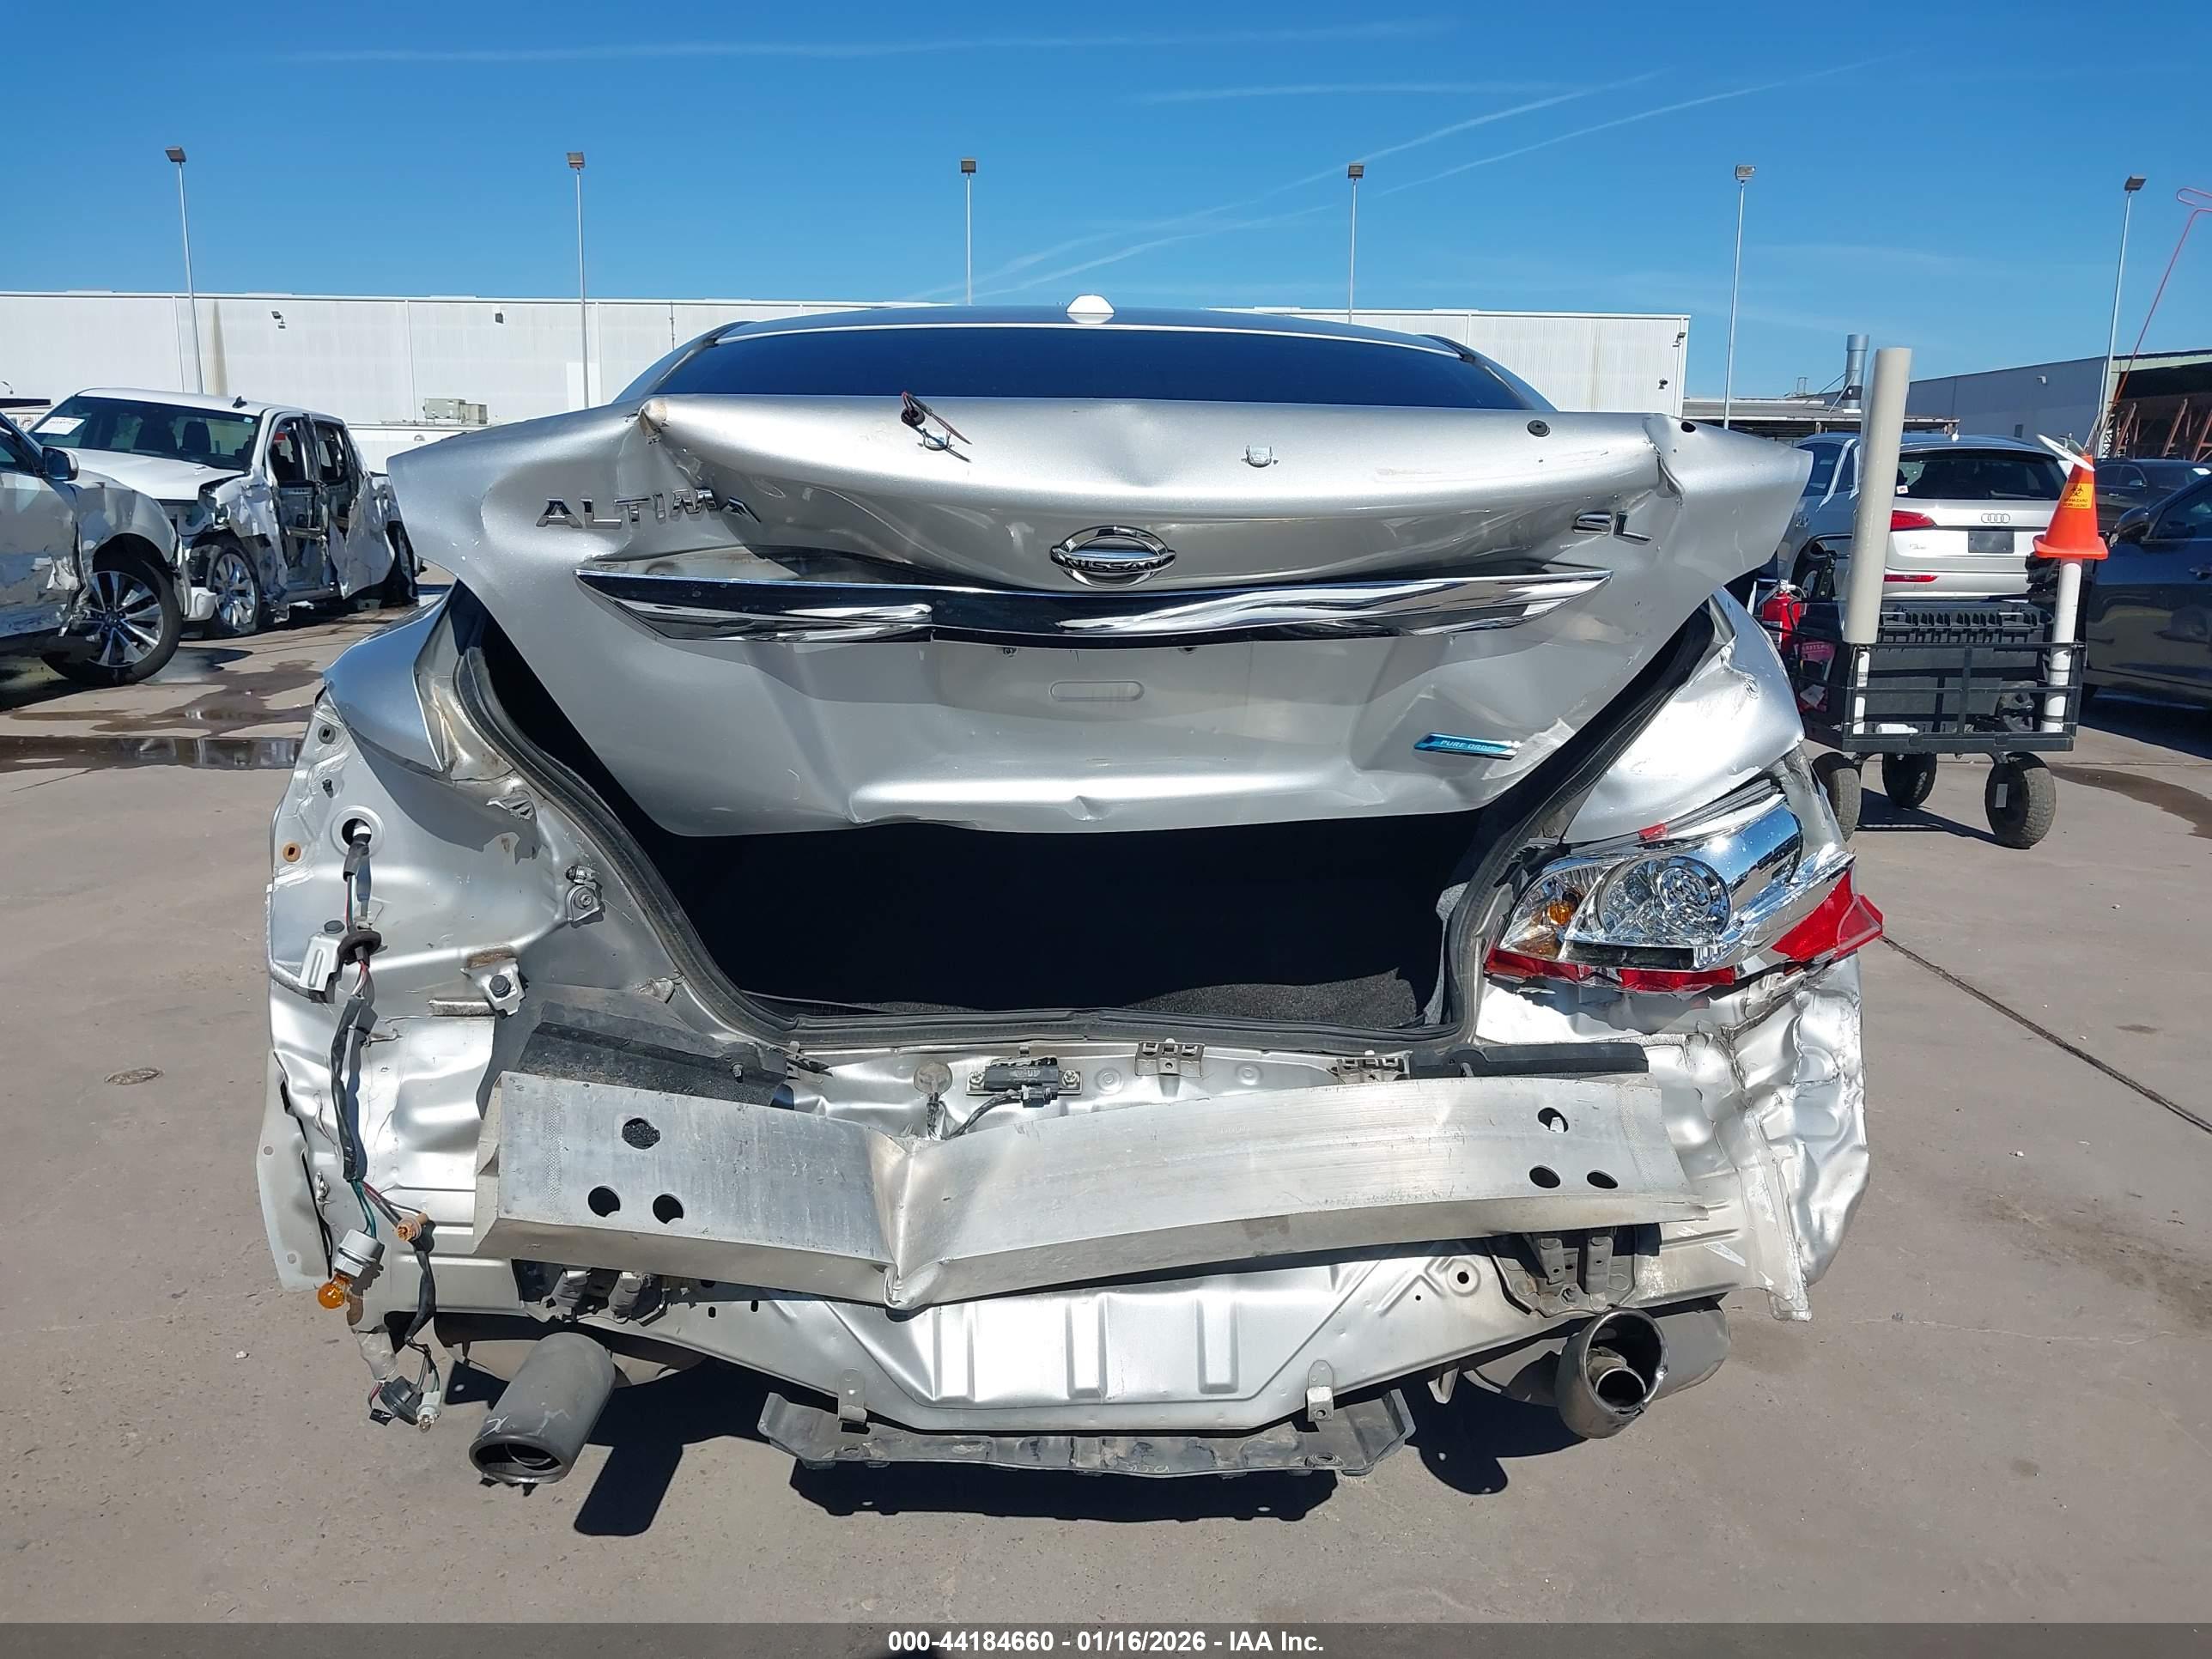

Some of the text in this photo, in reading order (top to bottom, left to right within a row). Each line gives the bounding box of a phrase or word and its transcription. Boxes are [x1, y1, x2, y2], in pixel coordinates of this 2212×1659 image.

[535, 488, 762, 529] ALTIMA
[1571, 512, 1654, 545] SL
[1066, 559, 1161, 572] NISSAN
